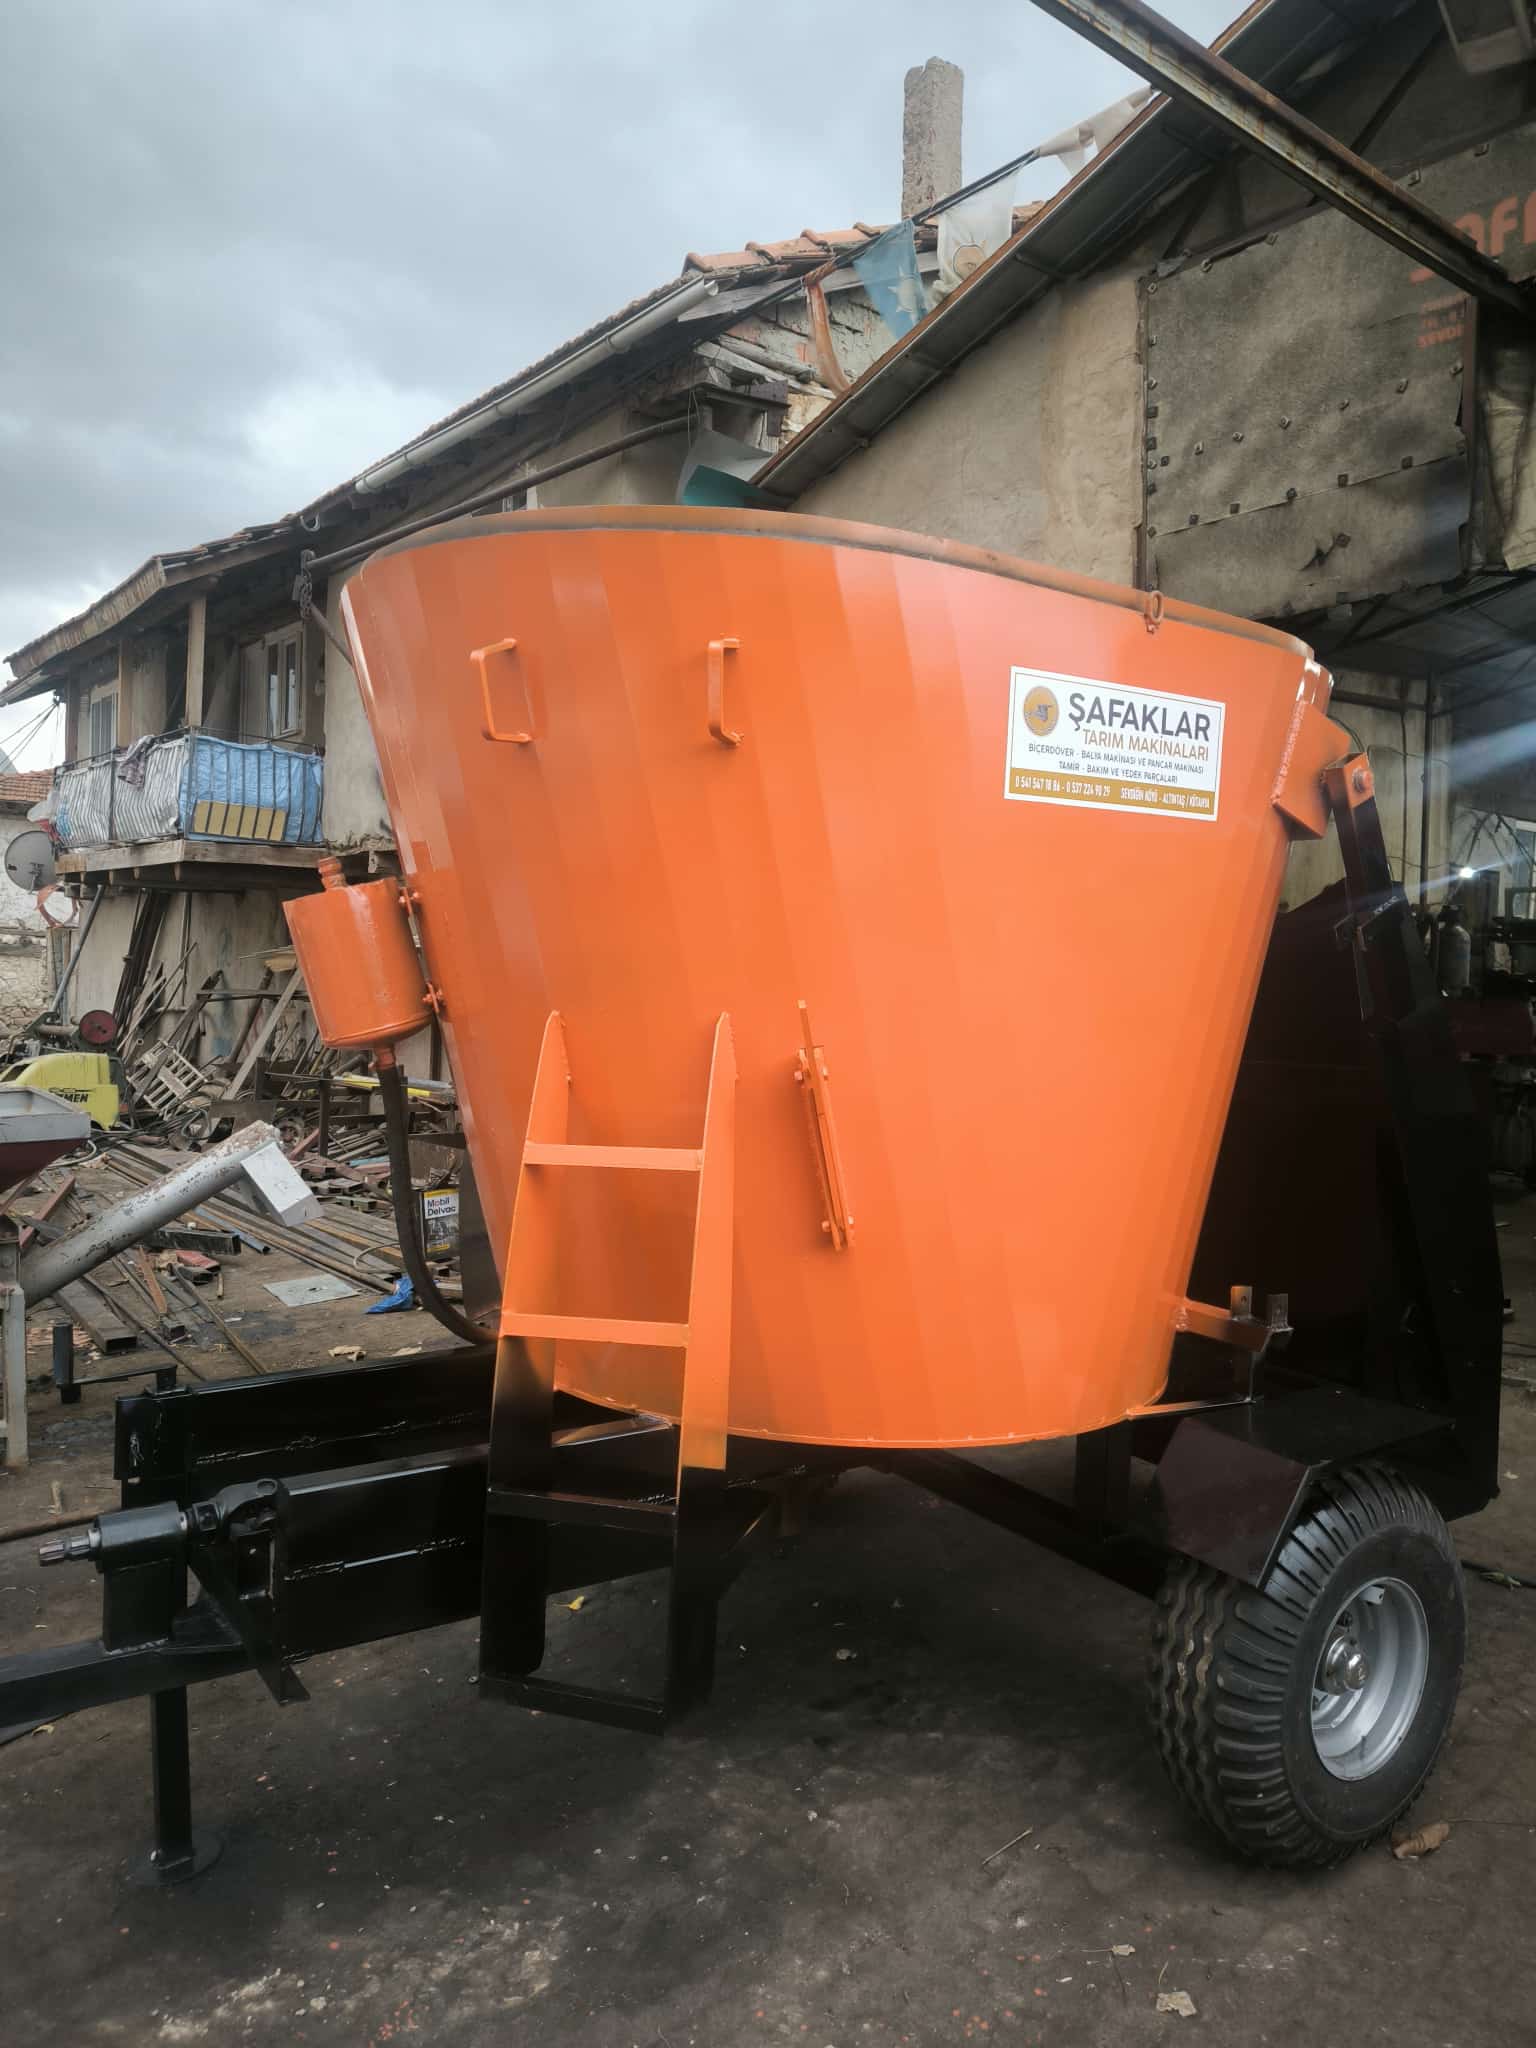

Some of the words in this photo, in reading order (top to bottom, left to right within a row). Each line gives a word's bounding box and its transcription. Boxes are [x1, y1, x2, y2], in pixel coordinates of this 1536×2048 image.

[1068, 691, 1211, 742] ŞAFAKLAR
[1082, 728, 1125, 751] TARIM
[1128, 734, 1209, 762] MAKİNALARI
[1137, 757, 1147, 767] VE
[1087, 765, 1109, 776] BAKIM
[1111, 768, 1120, 777] VE
[427, 1196, 450, 1209] Mobil
[427, 1205, 456, 1217] Delvac
